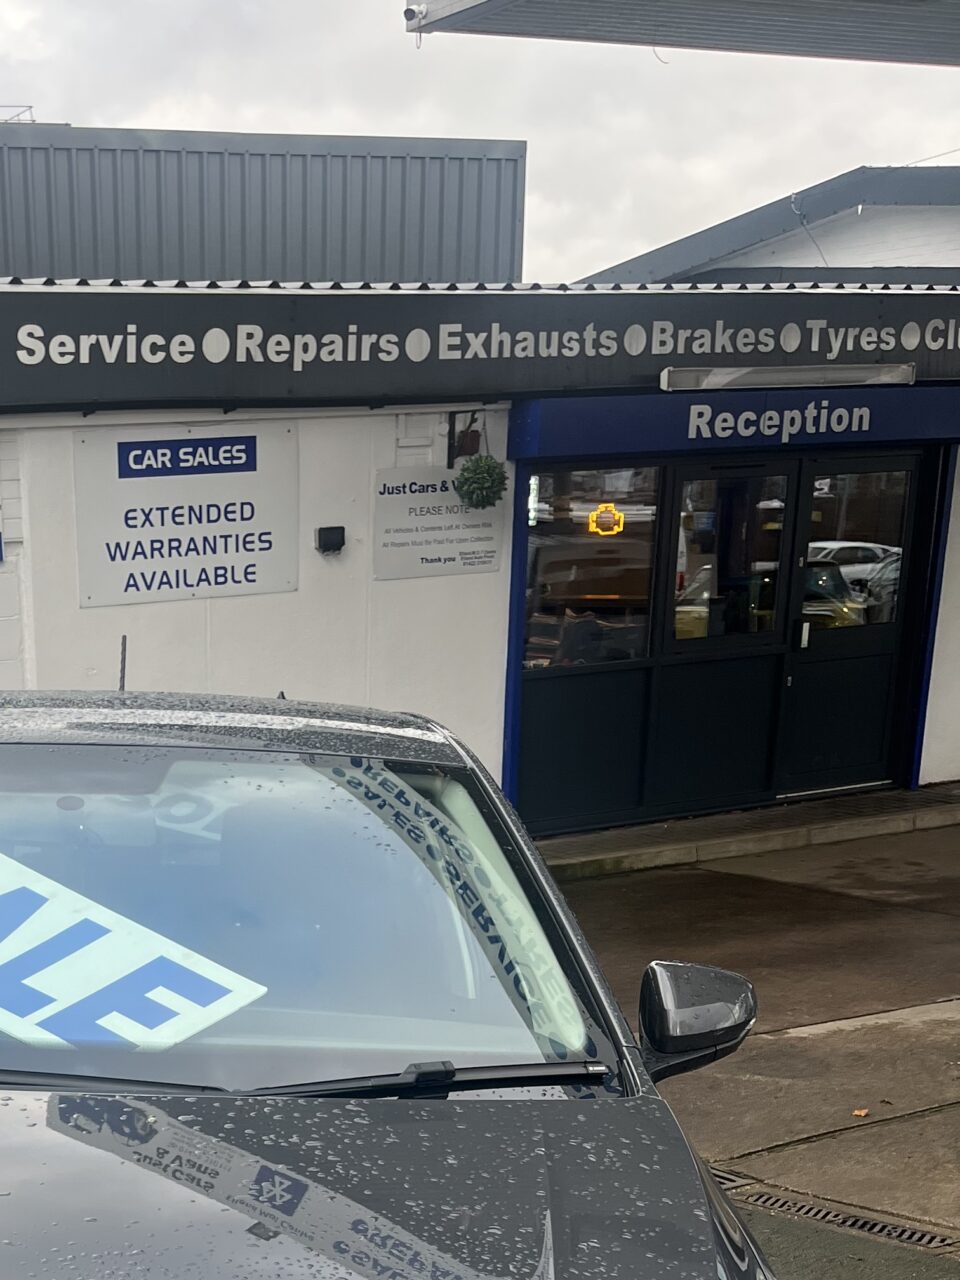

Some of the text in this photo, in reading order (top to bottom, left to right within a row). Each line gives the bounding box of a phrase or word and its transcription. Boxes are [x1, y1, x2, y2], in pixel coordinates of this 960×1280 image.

[16, 318, 960, 372] Service Repairs Exhausts Brakes Tyres Cl
[687, 400, 871, 443] Reception
[128, 445, 247, 470] CAR SALES
[378, 483, 407, 496] Just
[409, 481, 437, 494] Cars
[440, 480, 449, 492] &
[124, 501, 255, 529] EXTENDED
[408, 505, 470, 516] PLEASE NOTE
[105, 531, 273, 562] WARRANTIES
[444, 556, 456, 565] you
[124, 563, 257, 593] AVAILABLE
